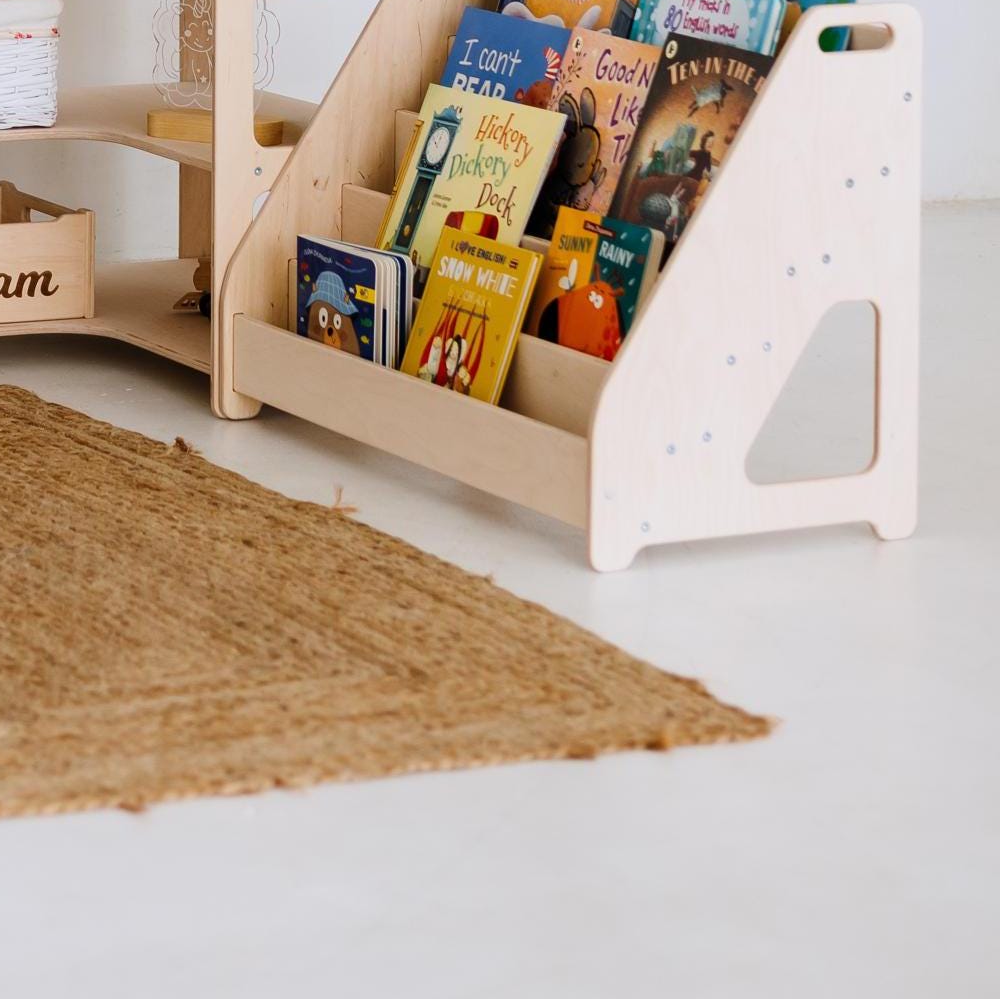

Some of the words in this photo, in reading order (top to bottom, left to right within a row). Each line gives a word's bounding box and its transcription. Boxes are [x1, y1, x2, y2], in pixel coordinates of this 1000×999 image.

[664, 4, 683, 32] 80
[683, 12, 710, 34] English
[458, 38, 479, 66] I
[478, 47, 522, 77] can't
[596, 48, 641, 84] Good
[610, 92, 641, 127] Lik
[474, 113, 534, 167] Hickory
[448, 143, 512, 187] Dickory
[475, 182, 517, 226] Dock
[559, 234, 593, 253] SUNNY
[598, 240, 636, 269] RAINY
[437, 255, 475, 284] SNOW
[475, 266, 519, 298] WHITE
